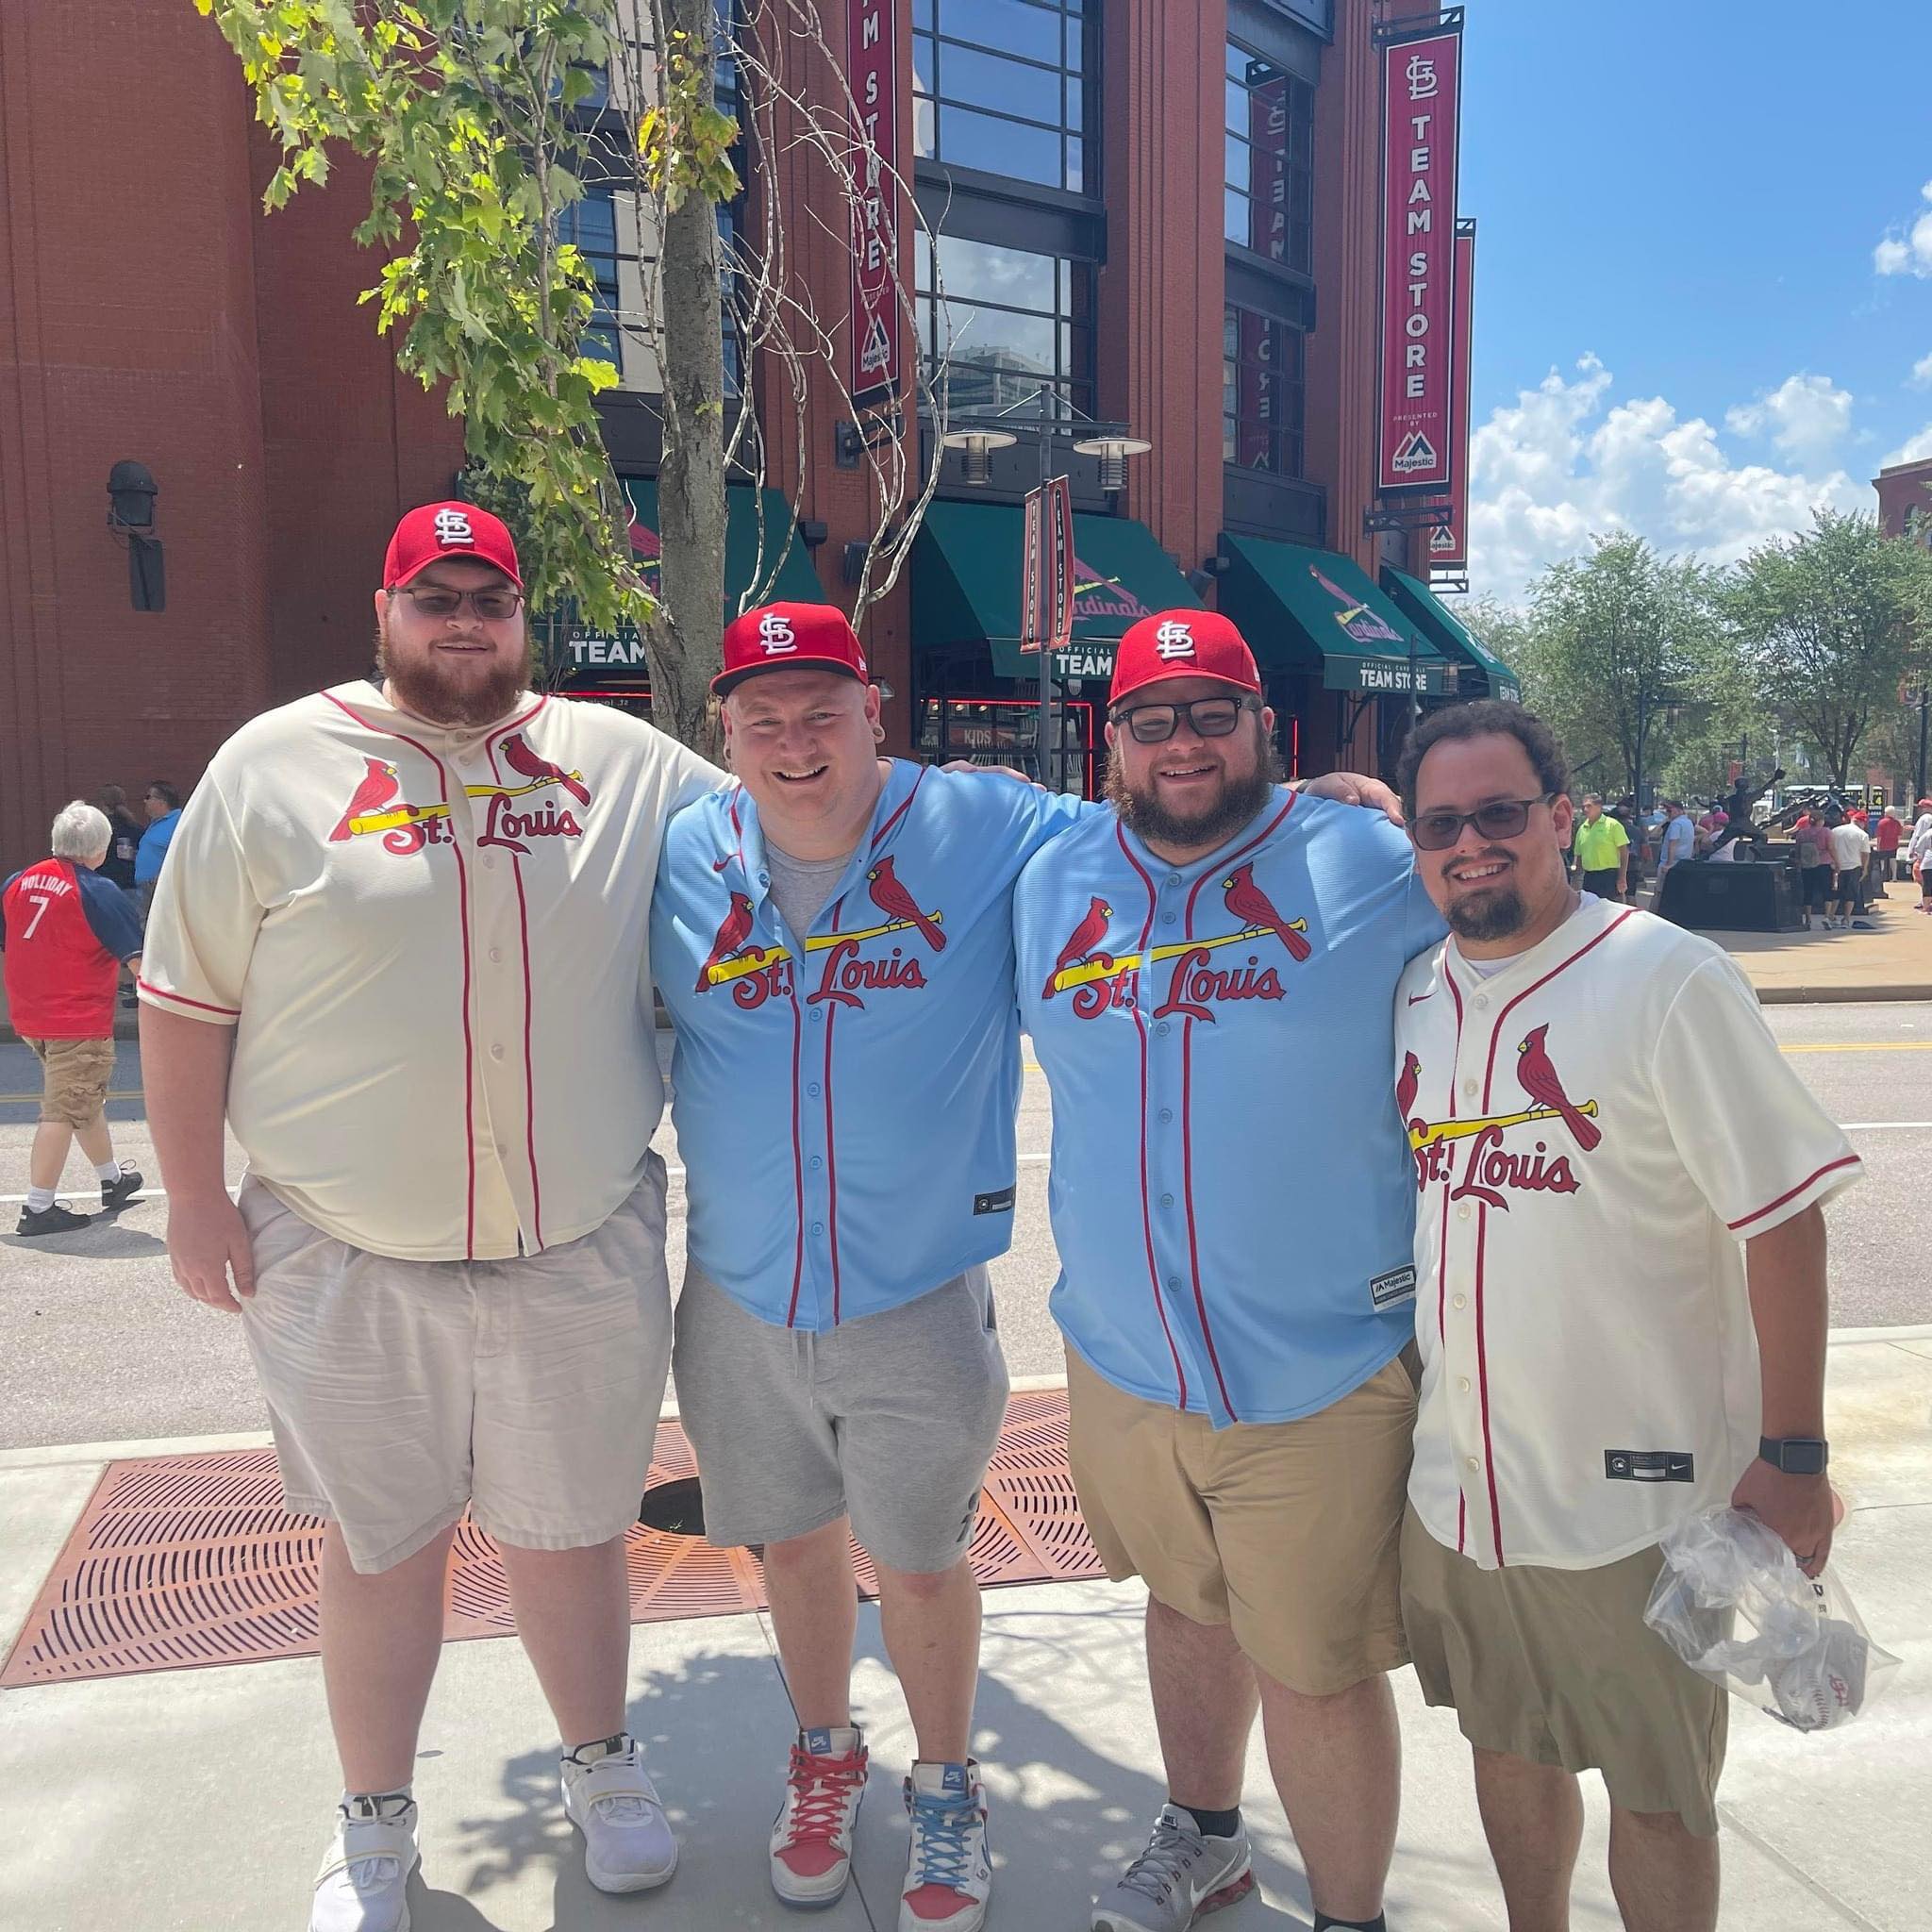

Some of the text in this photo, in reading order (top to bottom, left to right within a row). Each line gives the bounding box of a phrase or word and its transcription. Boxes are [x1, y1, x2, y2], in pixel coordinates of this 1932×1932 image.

[1406, 115, 1431, 398] TEAM STORE
[1392, 412, 1438, 422] PRESENTED
[1394, 458, 1434, 470] Majestic
[1430, 541, 1454, 550] ajestic
[1073, 594, 1152, 621] rdinals
[573, 631, 641, 640] OFFICIA
[569, 641, 648, 663] TEAM
[1058, 646, 1111, 655] OFFICIAL
[1057, 654, 1112, 675] TEAM
[1362, 662, 1425, 673] OFFICIAL CARDALS
[1360, 669, 1392, 688] TEAM
[964, 729, 991, 746] KIDS
[476, 792, 584, 856] Louis
[20, 874, 75, 896] HOLLIDAY
[23, 895, 49, 939] 7
[807, 939, 928, 1009] Louis
[1153, 947, 1287, 1024] Louis
[1451, 1124, 1581, 1212] Louis
[1383, 1274, 1411, 1289] Majestic
